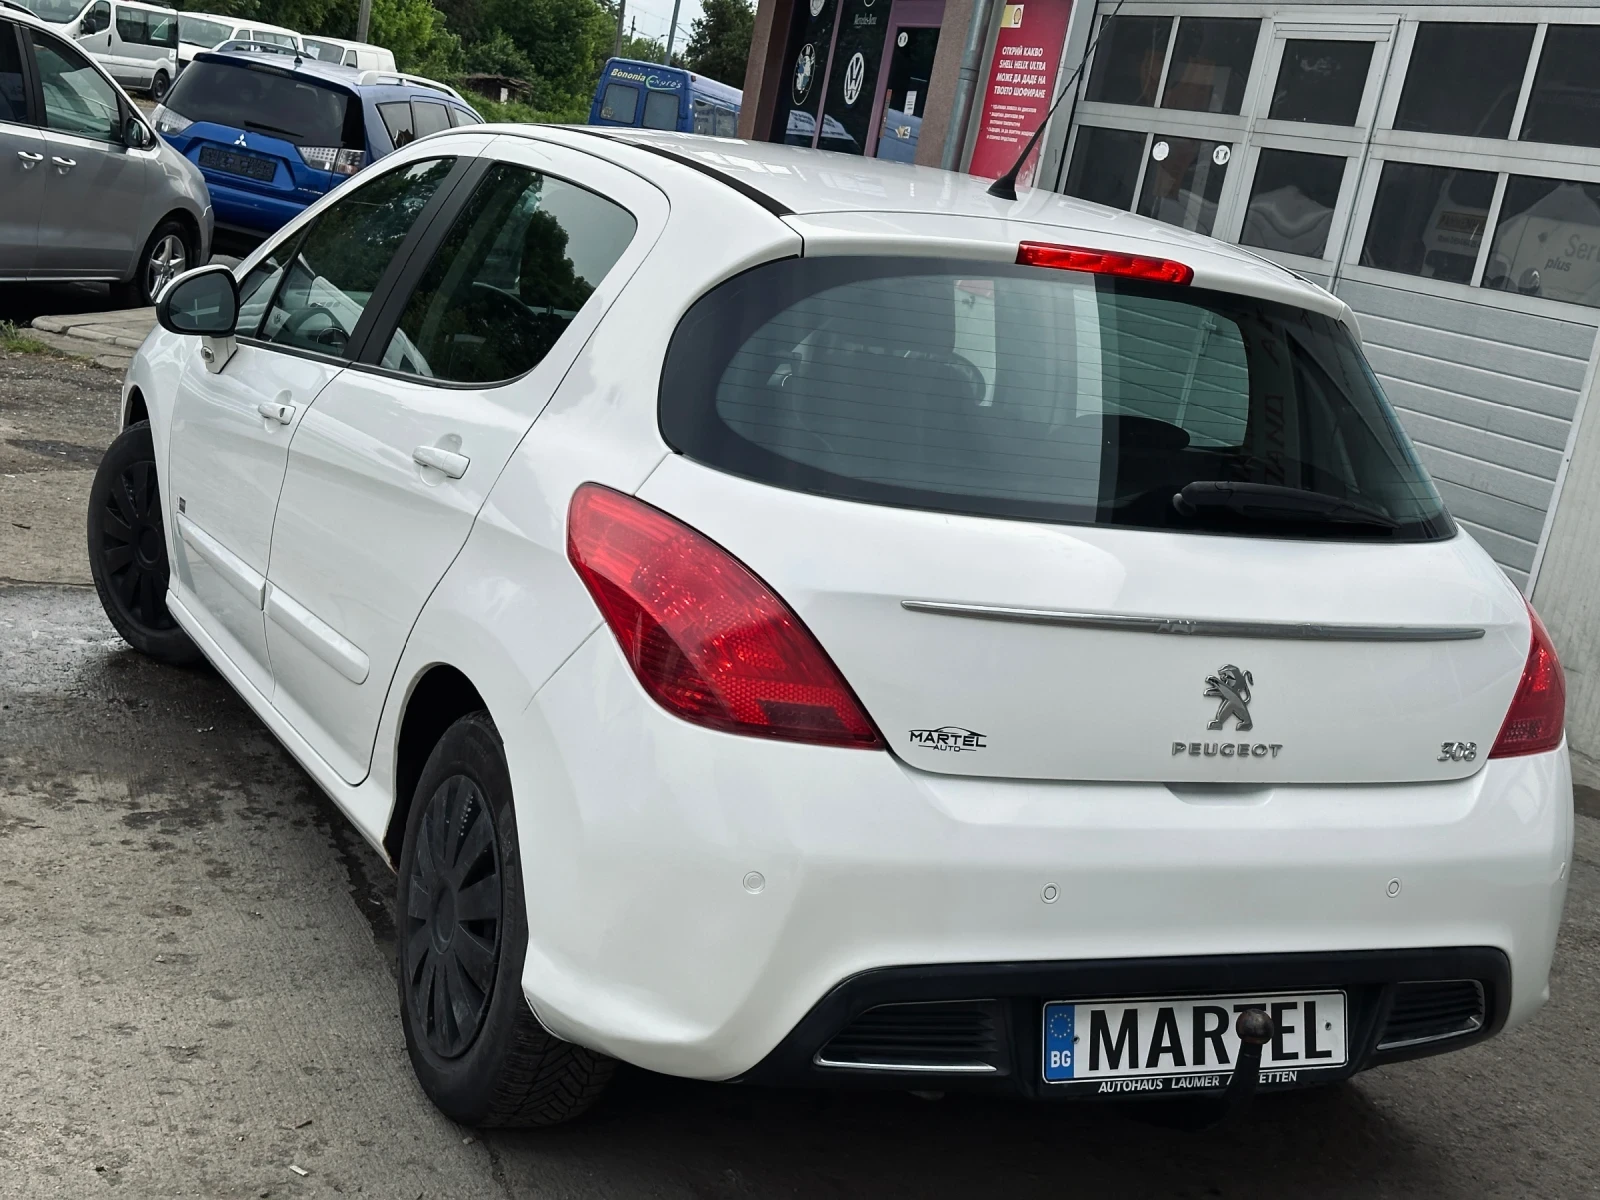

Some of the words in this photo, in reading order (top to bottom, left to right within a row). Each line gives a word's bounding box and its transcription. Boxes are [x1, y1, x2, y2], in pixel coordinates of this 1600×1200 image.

[1002, 45, 1022, 55] ОТКРИЙ
[1023, 47, 1043, 57] КАКВО
[999, 60, 1013, 69] SHELL
[1014, 60, 1029, 70] HELIX
[1030, 61, 1046, 71] ULTRA
[610, 68, 646, 82] Bononia
[996, 73, 1013, 82] МОЖЕ
[1012, 74, 1020, 84] ДА
[1038, 76, 1046, 85] НА
[994, 85, 1013, 95] ТВОЕТО
[1013, 87, 1046, 98] ШОФИРАНЕ
[1544, 256, 1573, 273] plus
[909, 731, 987, 748] MARTEL
[933, 744, 961, 753] AUTO
[1172, 742, 1284, 758] PEUGEOT
[1437, 741, 1477, 762] 308
[1050, 1050, 1071, 1068] BG
[1098, 1078, 1164, 1094] AUTOHAUS
[1171, 1075, 1220, 1090] LAUMER
[1258, 1071, 1298, 1084] ETTEN
